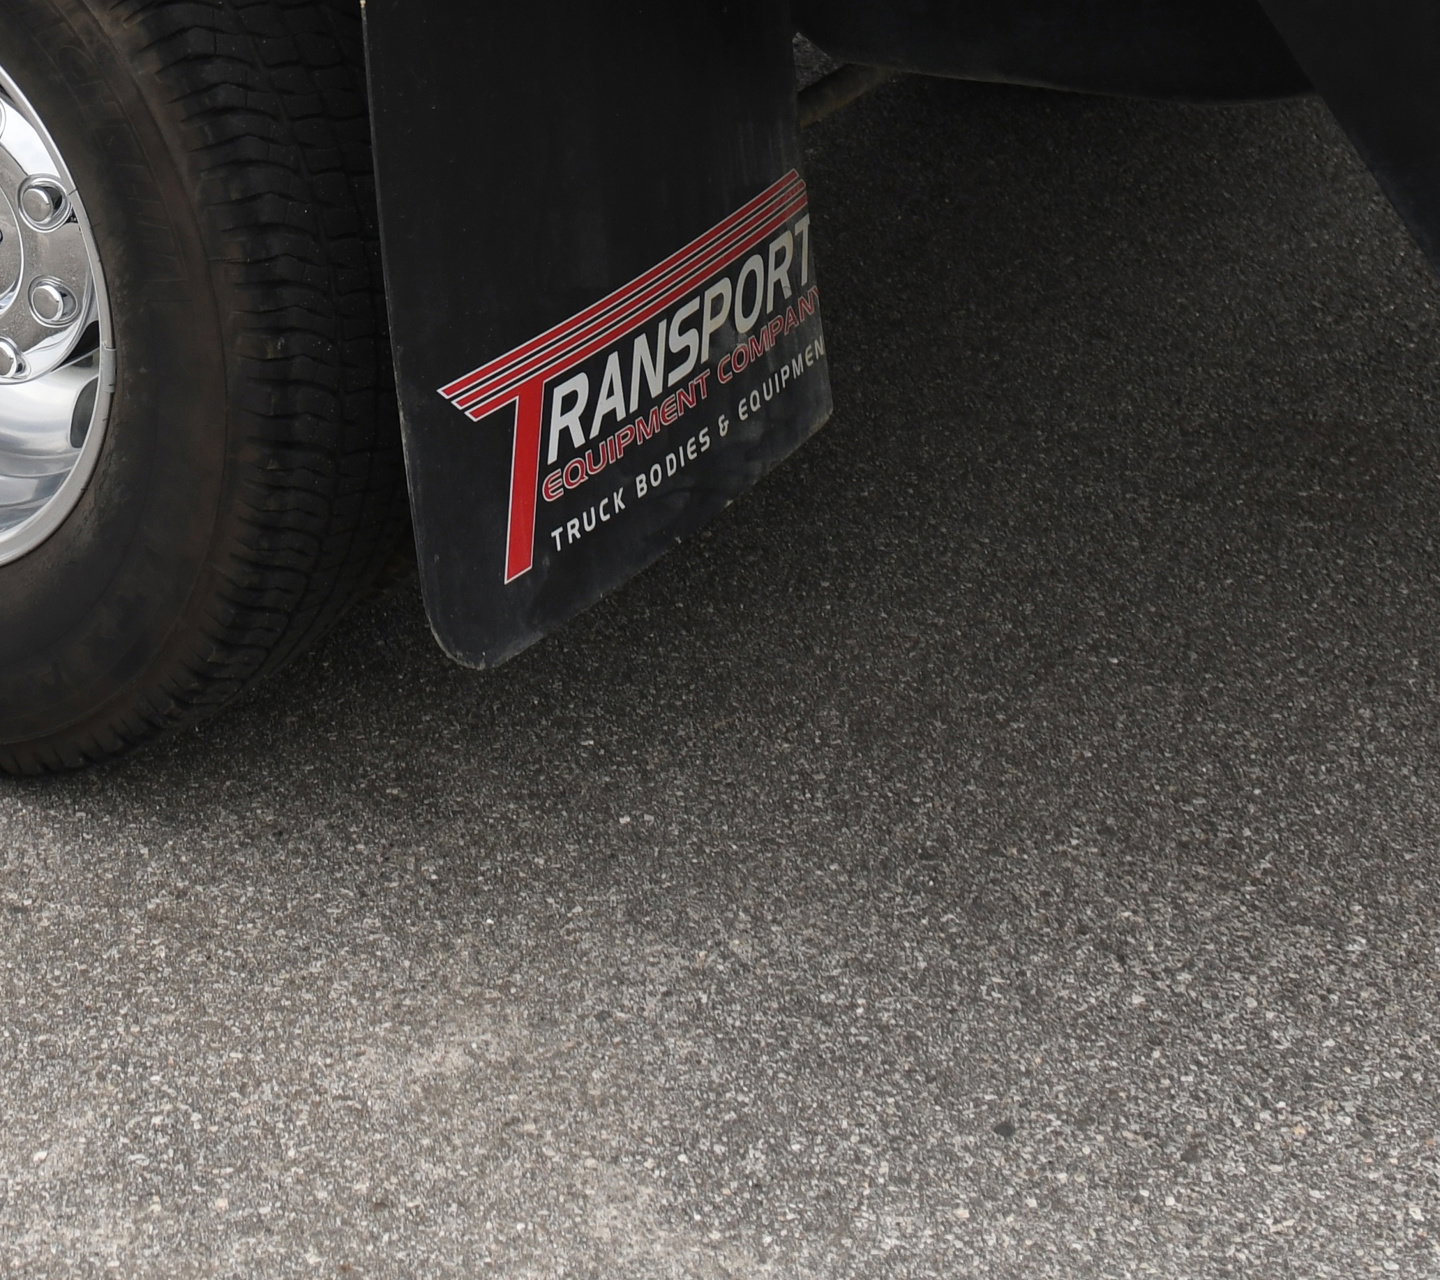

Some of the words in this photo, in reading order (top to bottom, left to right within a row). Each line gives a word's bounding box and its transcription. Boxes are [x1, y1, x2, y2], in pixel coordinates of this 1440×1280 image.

[465, 185, 811, 584] TRANSPORT
[542, 368, 710, 502] EQUIPMENT
[550, 492, 626, 552] TRUCK
[635, 427, 711, 498] BODIES
[717, 415, 730, 437] &
[737, 336, 826, 422] EQUIPMEN
